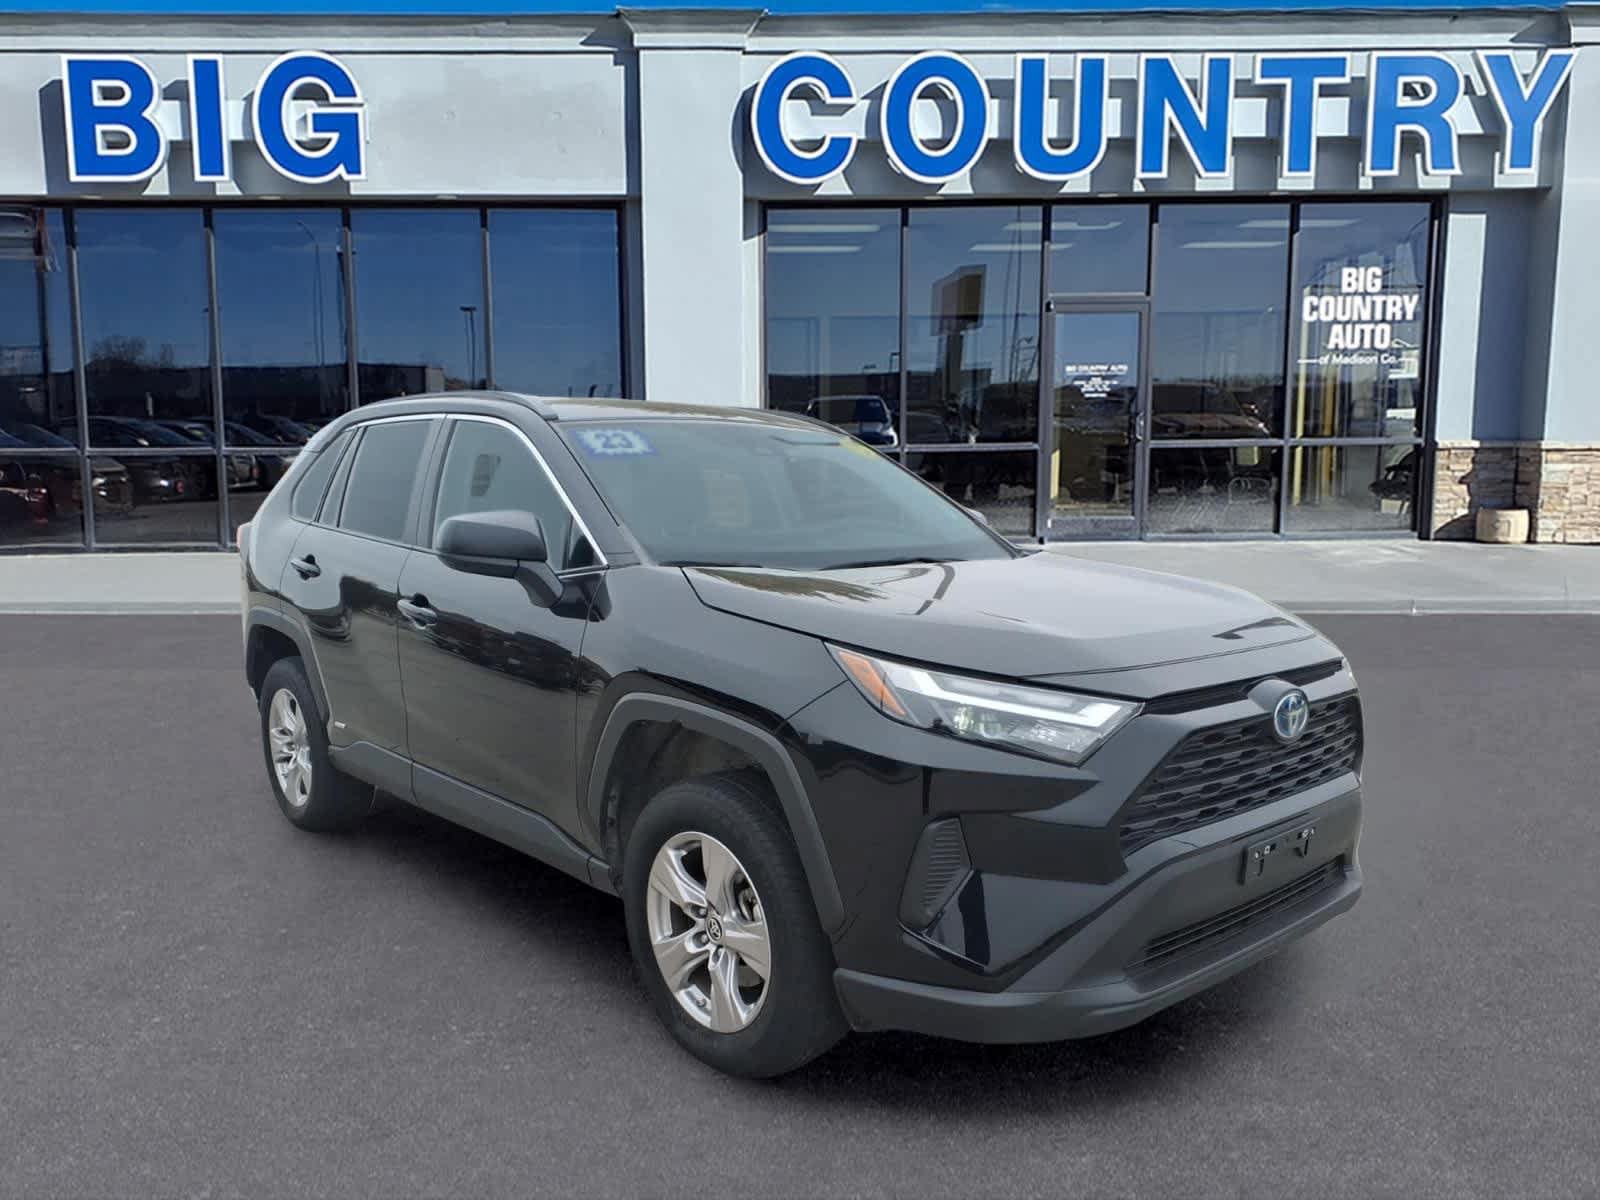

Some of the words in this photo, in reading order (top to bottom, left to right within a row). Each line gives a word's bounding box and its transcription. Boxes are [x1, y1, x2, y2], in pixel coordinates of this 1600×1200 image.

[61, 50, 368, 184] BIG
[751, 49, 1577, 185] COUNTRY
[1341, 266, 1382, 293] BIG
[1303, 295, 1419, 321] COUNTRY
[1327, 323, 1391, 349] AUTO
